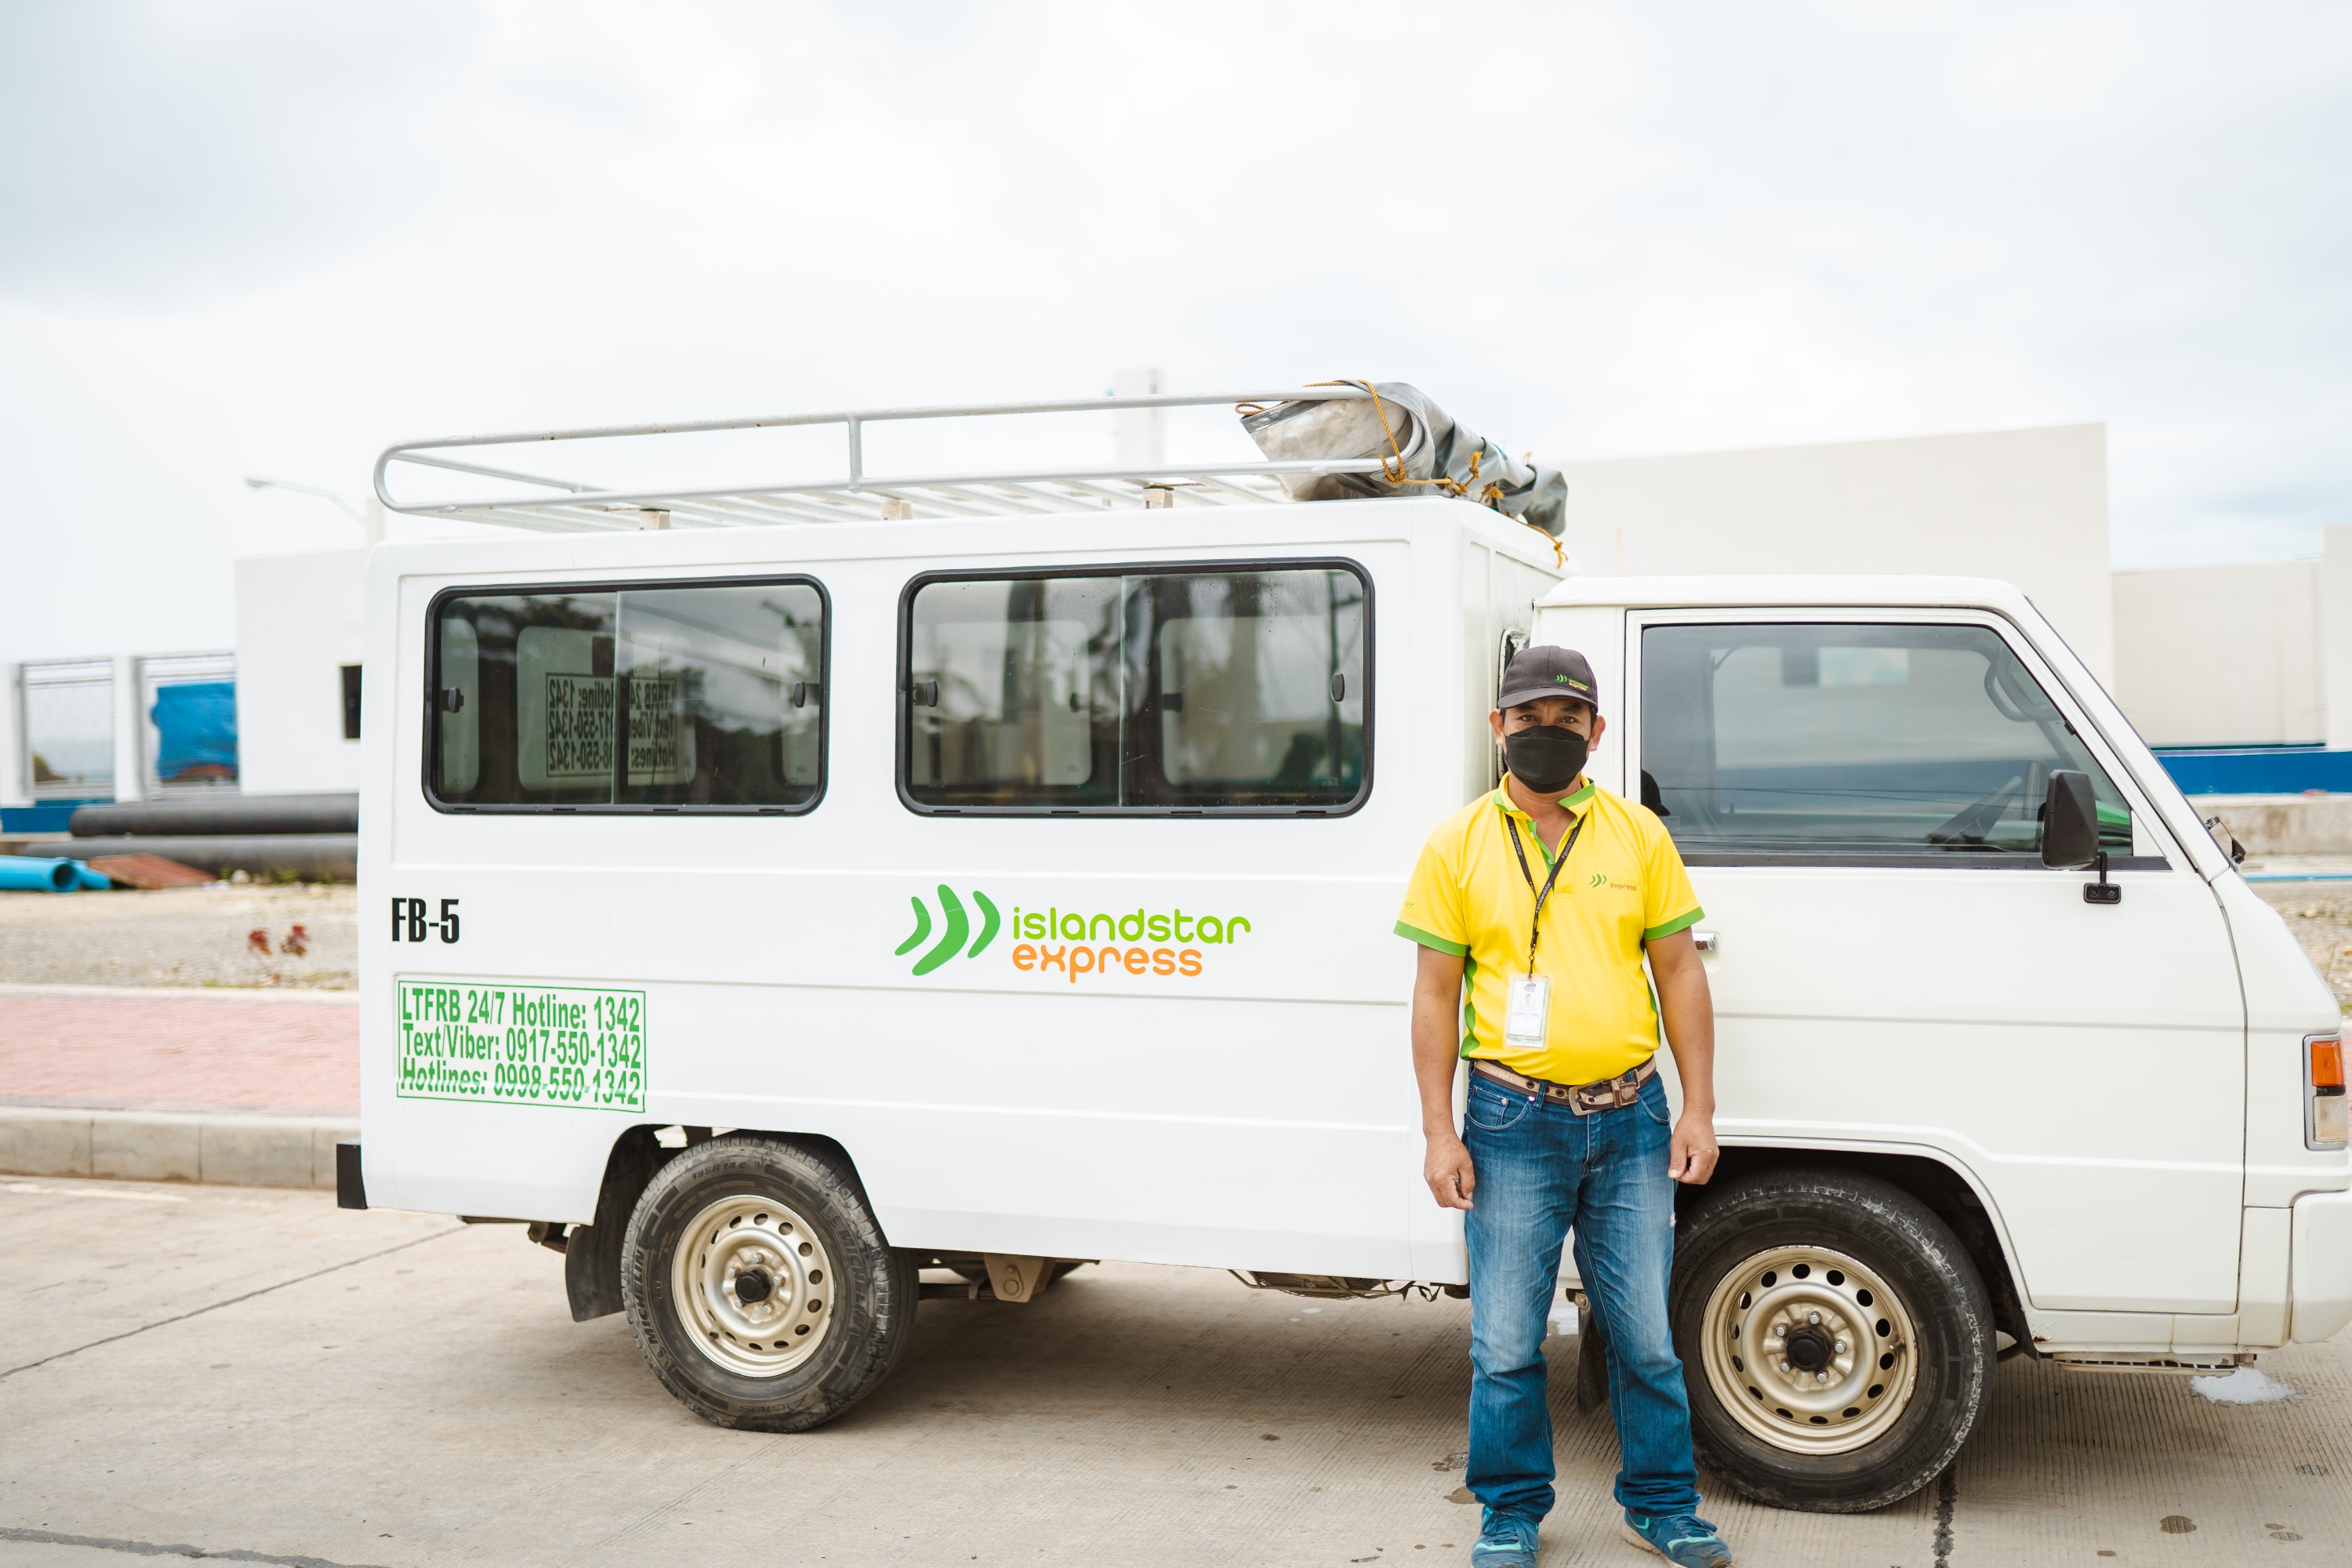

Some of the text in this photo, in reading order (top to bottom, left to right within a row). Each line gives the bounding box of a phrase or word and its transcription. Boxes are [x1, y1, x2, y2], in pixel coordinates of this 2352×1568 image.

[1610, 883, 1637, 891] express
[392, 898, 459, 943] FB-5
[1014, 906, 1251, 944] islandstar
[1012, 944, 1203, 983] express
[403, 988, 640, 1032] LTFRB 24/7 Hotline: 1342
[403, 1022, 641, 1069] Text/Viber: 0917-550-1342
[401, 1057, 640, 1105] Hotlines: 0998-550-1342
[1857, 1219, 1950, 1310] MICHELIN
[633, 1248, 659, 1344] MICHELIN
